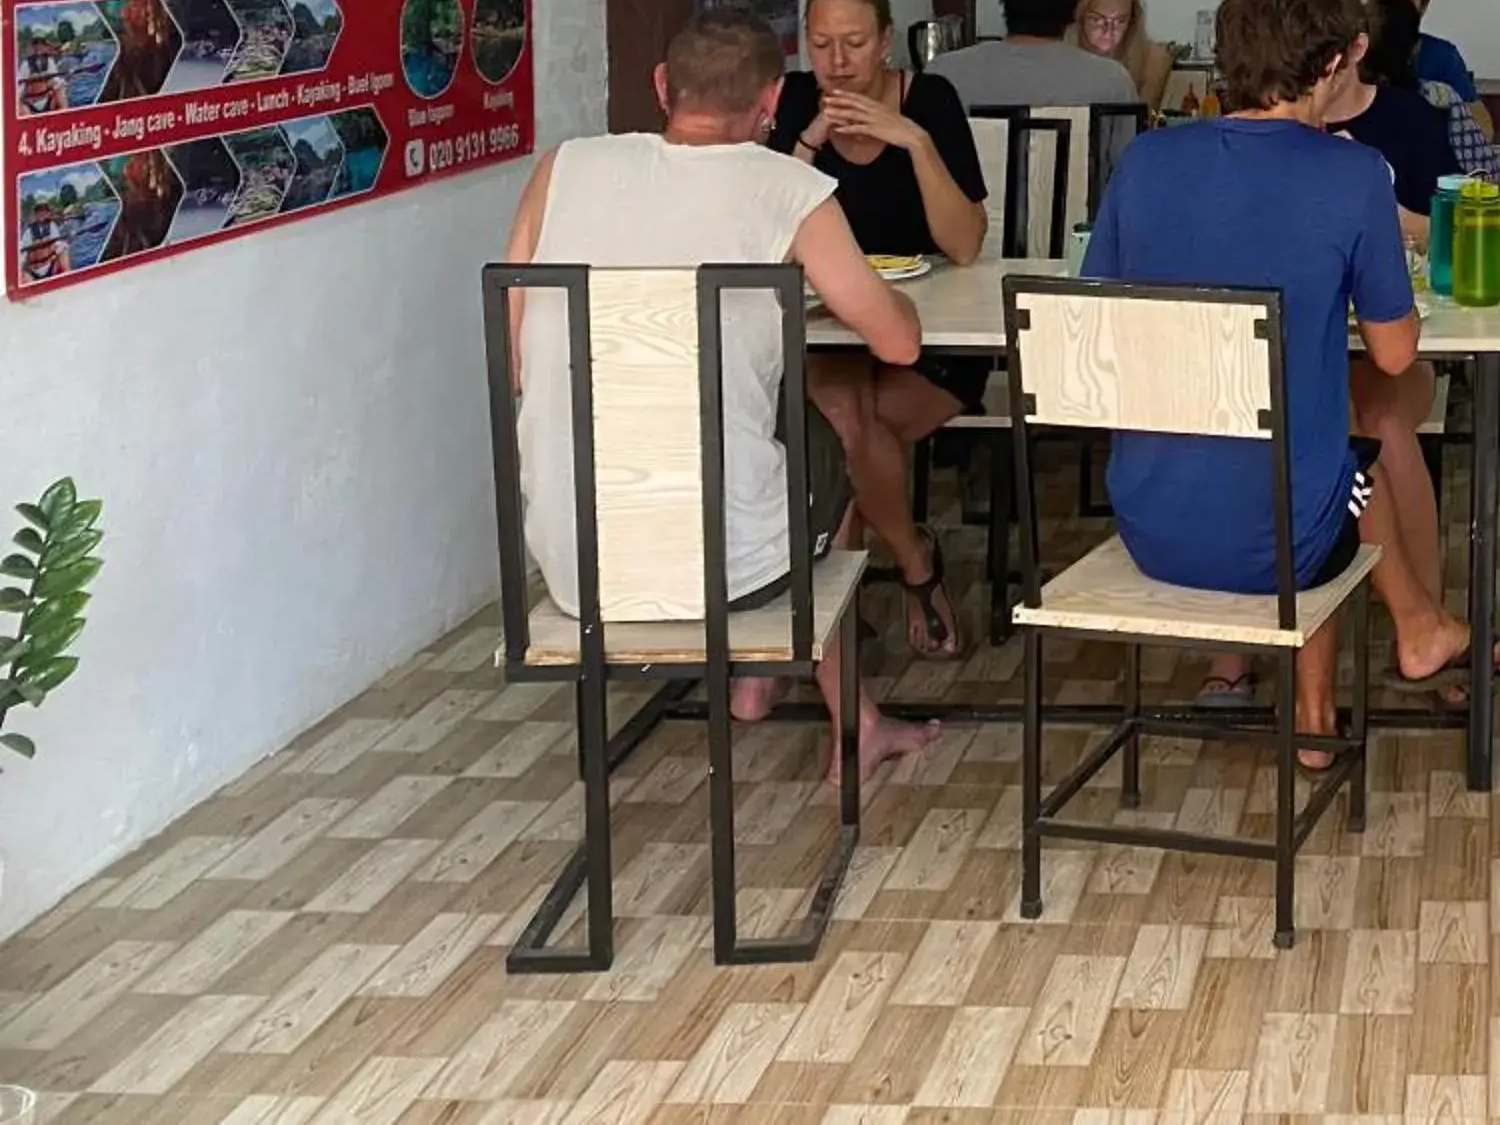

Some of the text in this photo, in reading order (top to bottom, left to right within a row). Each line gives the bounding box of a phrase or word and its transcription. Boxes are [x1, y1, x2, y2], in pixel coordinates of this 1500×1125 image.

[17, 131, 33, 156] 4.
[36, 122, 101, 156] Kayaking
[112, 114, 145, 140] Jang
[147, 111, 175, 132] cave
[185, 101, 220, 125] Water
[222, 97, 249, 118] cave
[257, 88, 289, 112] Lunch
[297, 80, 341, 106] Kayaking
[429, 139, 454, 170] 020
[455, 131, 485, 163] 9131
